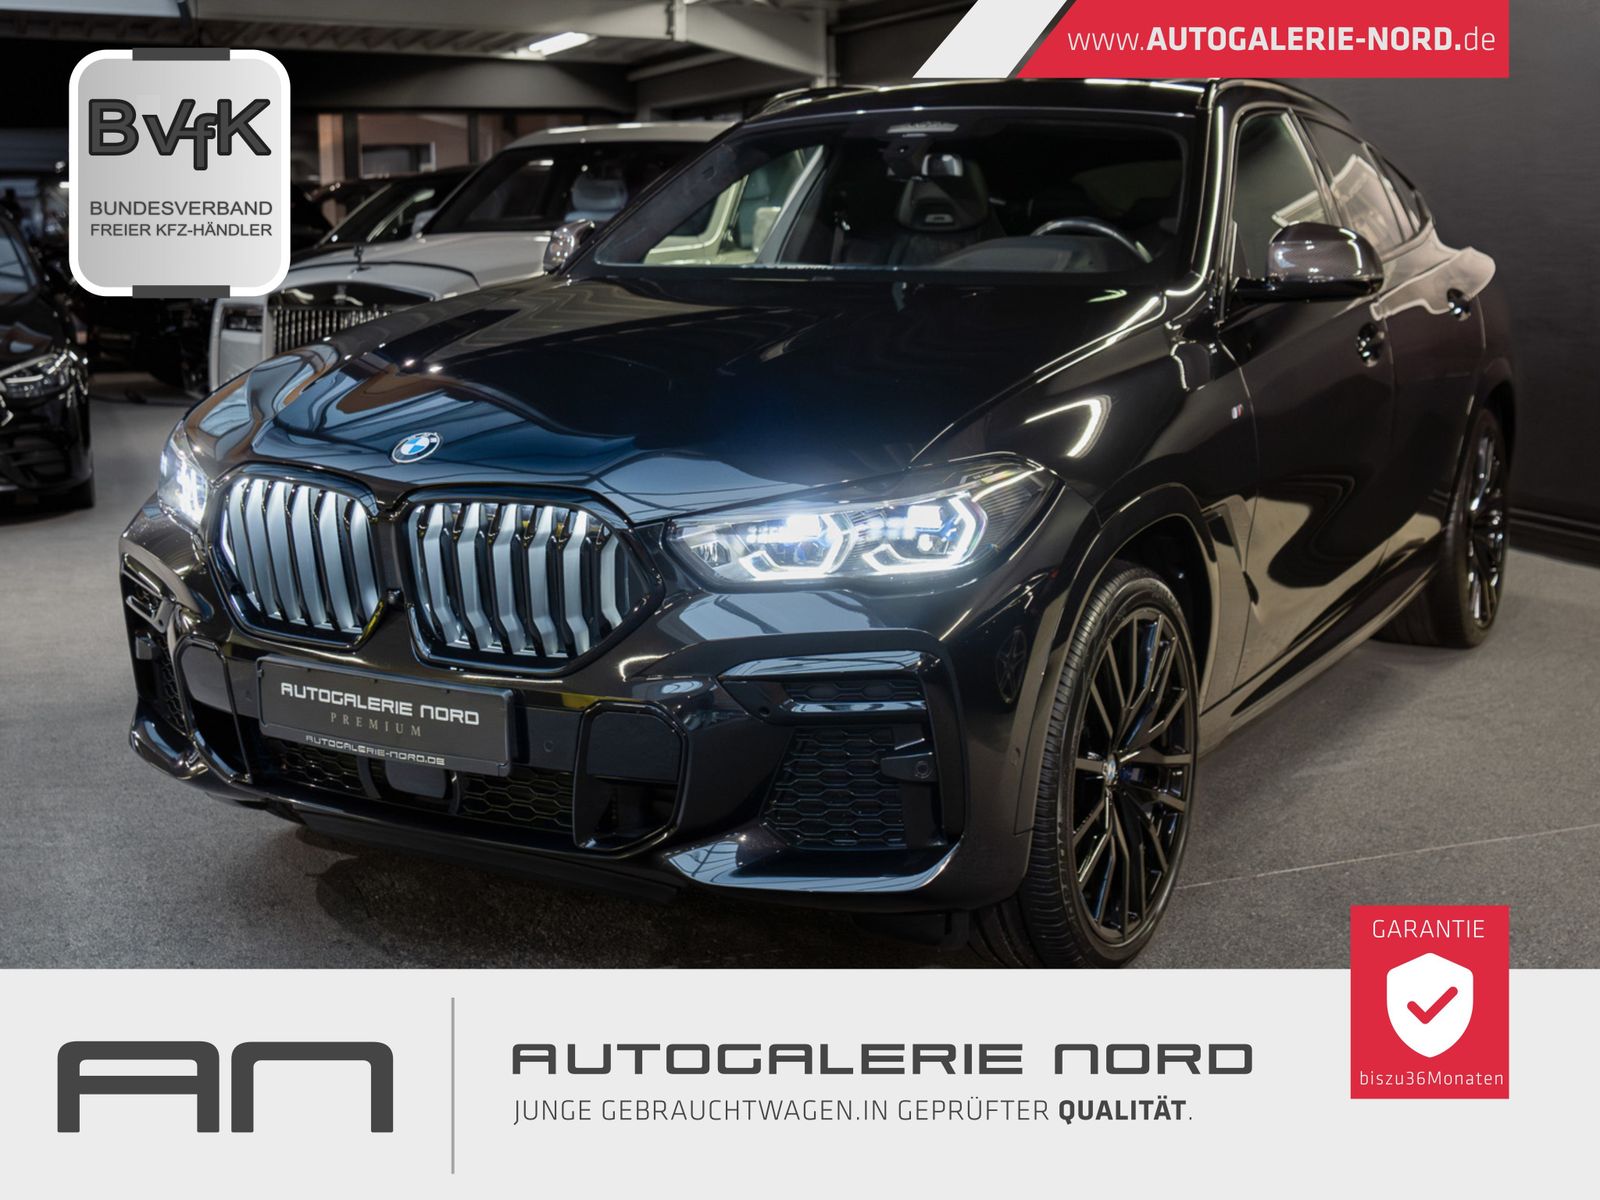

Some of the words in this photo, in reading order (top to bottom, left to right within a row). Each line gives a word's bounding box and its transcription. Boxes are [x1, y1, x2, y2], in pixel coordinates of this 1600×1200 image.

[280, 682, 413, 717] AUTOGALERIE
[420, 705, 480, 726] NORD
[330, 712, 422, 737] PREMIUM
